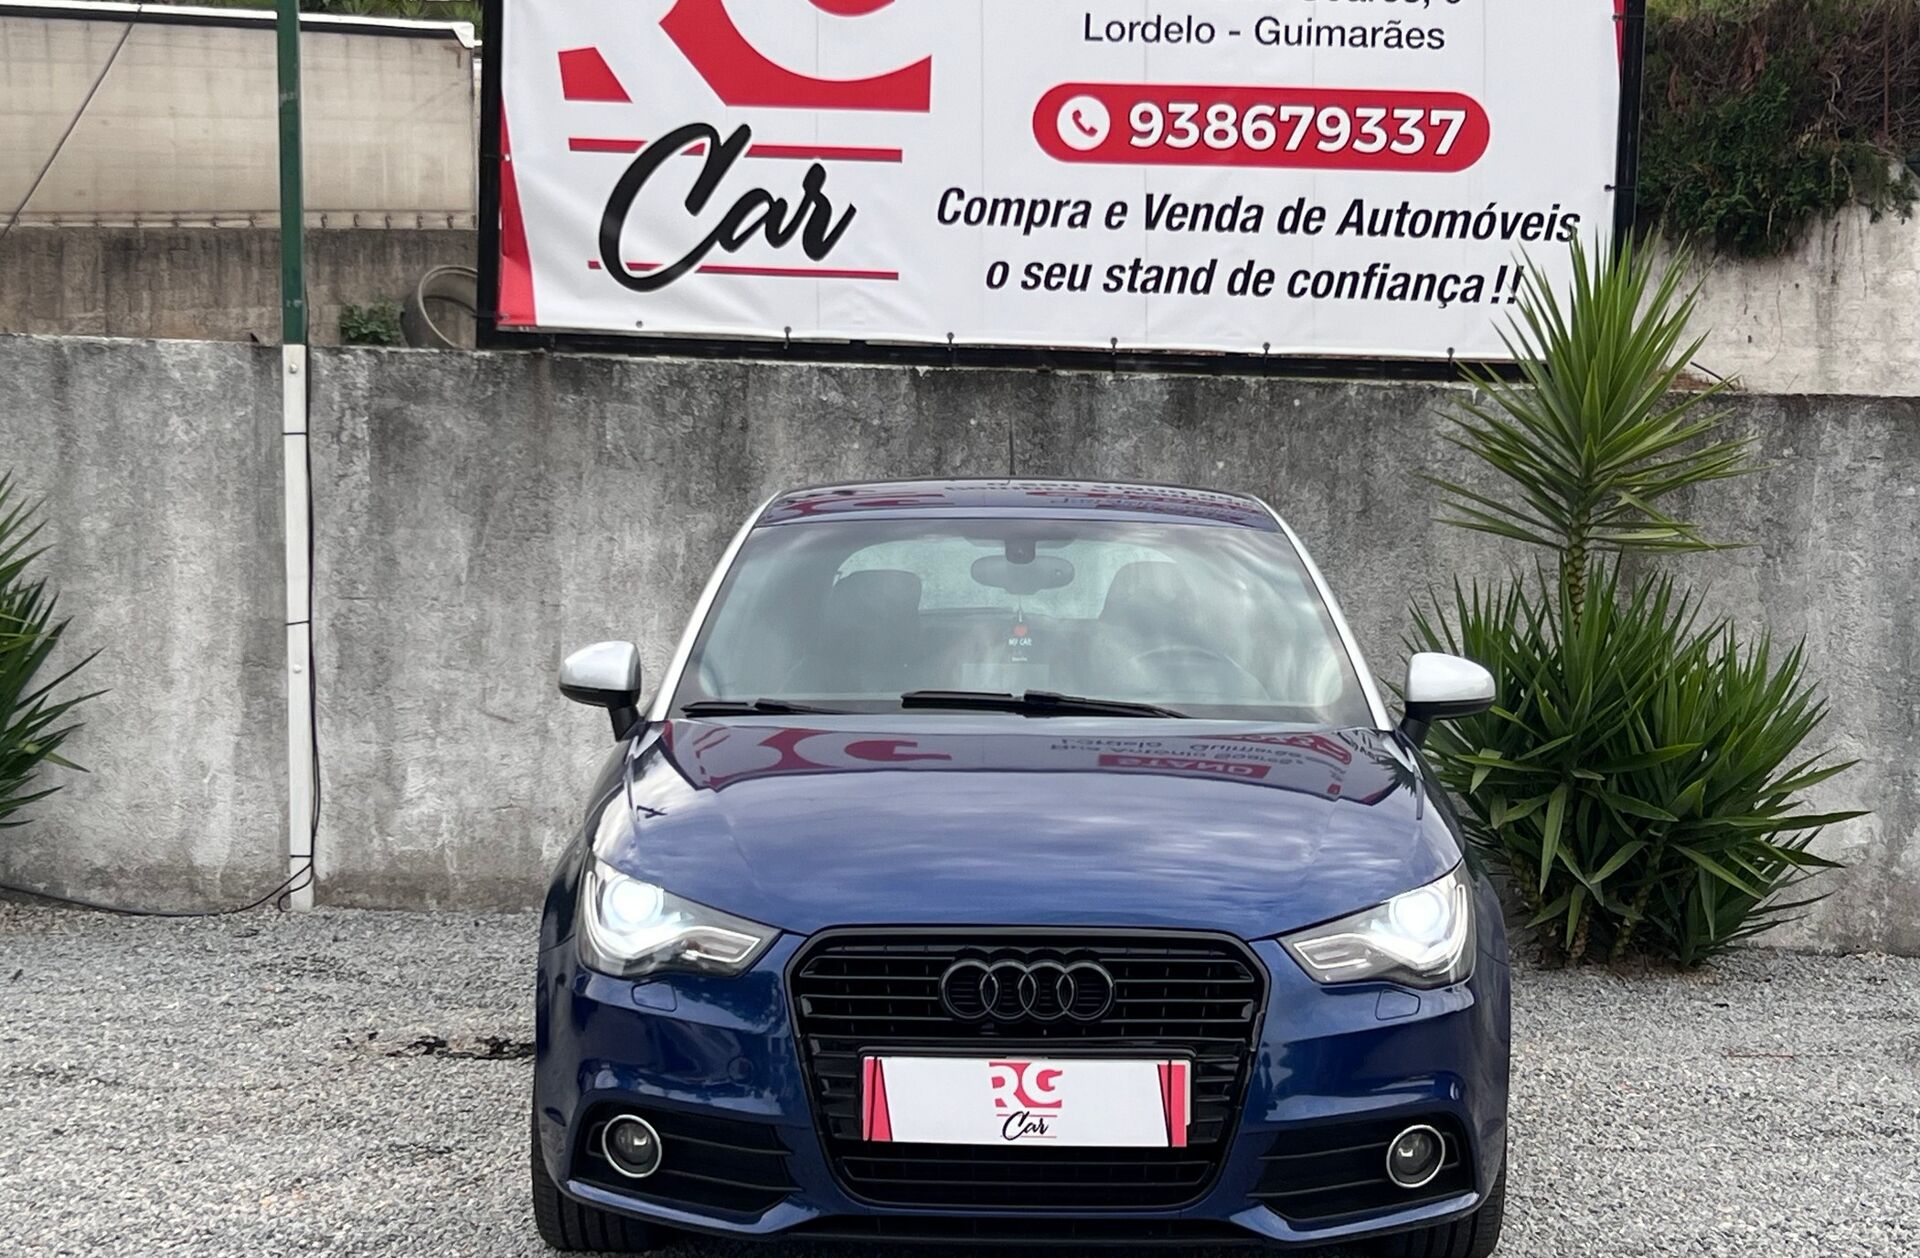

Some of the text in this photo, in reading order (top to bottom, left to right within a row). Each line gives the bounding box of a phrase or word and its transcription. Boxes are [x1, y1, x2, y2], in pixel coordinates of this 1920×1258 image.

[1084, 12, 1216, 44] Lordelo
[1254, 15, 1445, 50] Guimarães
[1128, 101, 1467, 157] 938679337
[599, 122, 857, 292] Car
[937, 187, 1581, 242] Compra e Venda de Automóveis
[986, 261, 1010, 290] o
[1020, 262, 1093, 292] seu
[1102, 257, 1218, 295] stand
[1227, 259, 1275, 297] de
[989, 1062, 1063, 1108] RG
[1002, 1110, 1050, 1141] Car
